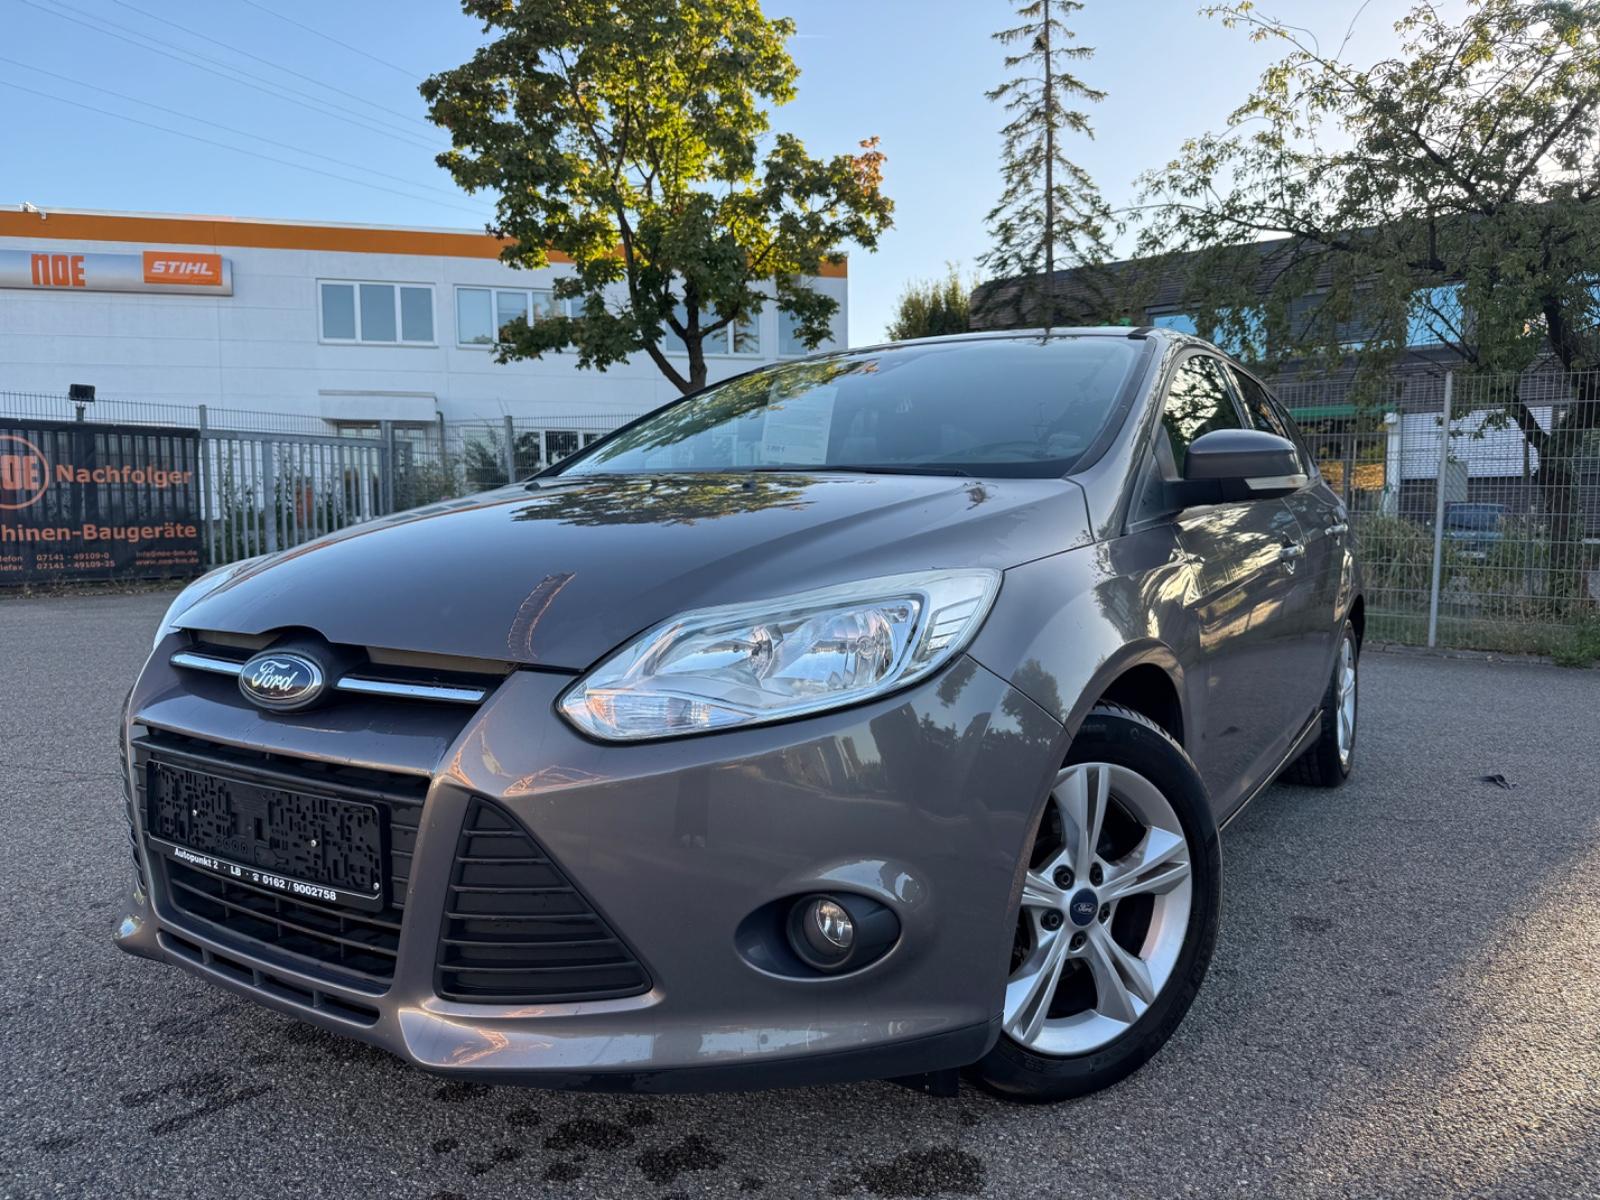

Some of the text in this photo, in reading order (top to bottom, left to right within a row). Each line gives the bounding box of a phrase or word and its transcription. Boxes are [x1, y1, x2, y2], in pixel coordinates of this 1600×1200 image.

[151, 260, 213, 275] STIHL
[56, 464, 192, 488] Nachfolger
[1, 522, 197, 543] hinen-Baugeräte
[252, 660, 298, 692] Ford
[174, 847, 212, 869] Autopunkt
[212, 857, 219, 870] 2
[230, 865, 242, 877] LB
[262, 874, 285, 890] 0162
[293, 882, 337, 902] 9002758
